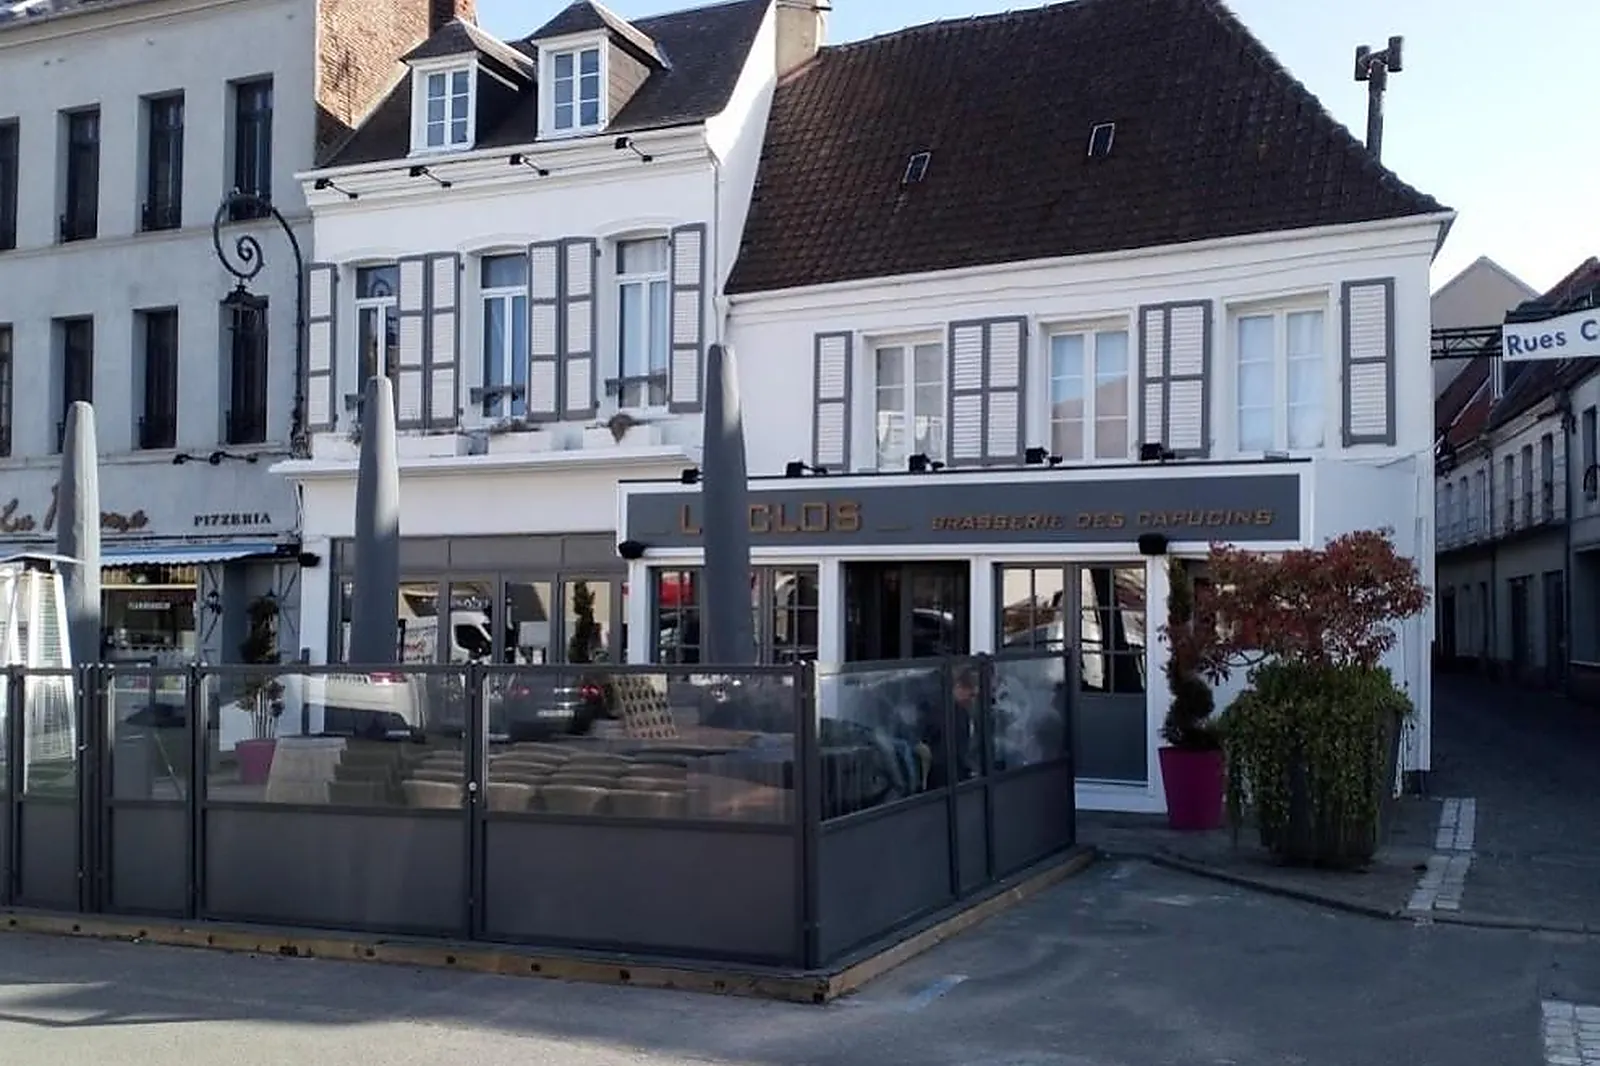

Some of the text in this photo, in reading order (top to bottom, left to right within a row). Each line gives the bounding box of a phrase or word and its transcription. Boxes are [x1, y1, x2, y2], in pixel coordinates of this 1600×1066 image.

[1507, 331, 1567, 356] Rues
[193, 512, 272, 527] PIZZERIA
[748, 502, 861, 532] CLOS
[932, 508, 1275, 531] BRASSERIE DES CAPUCINS
